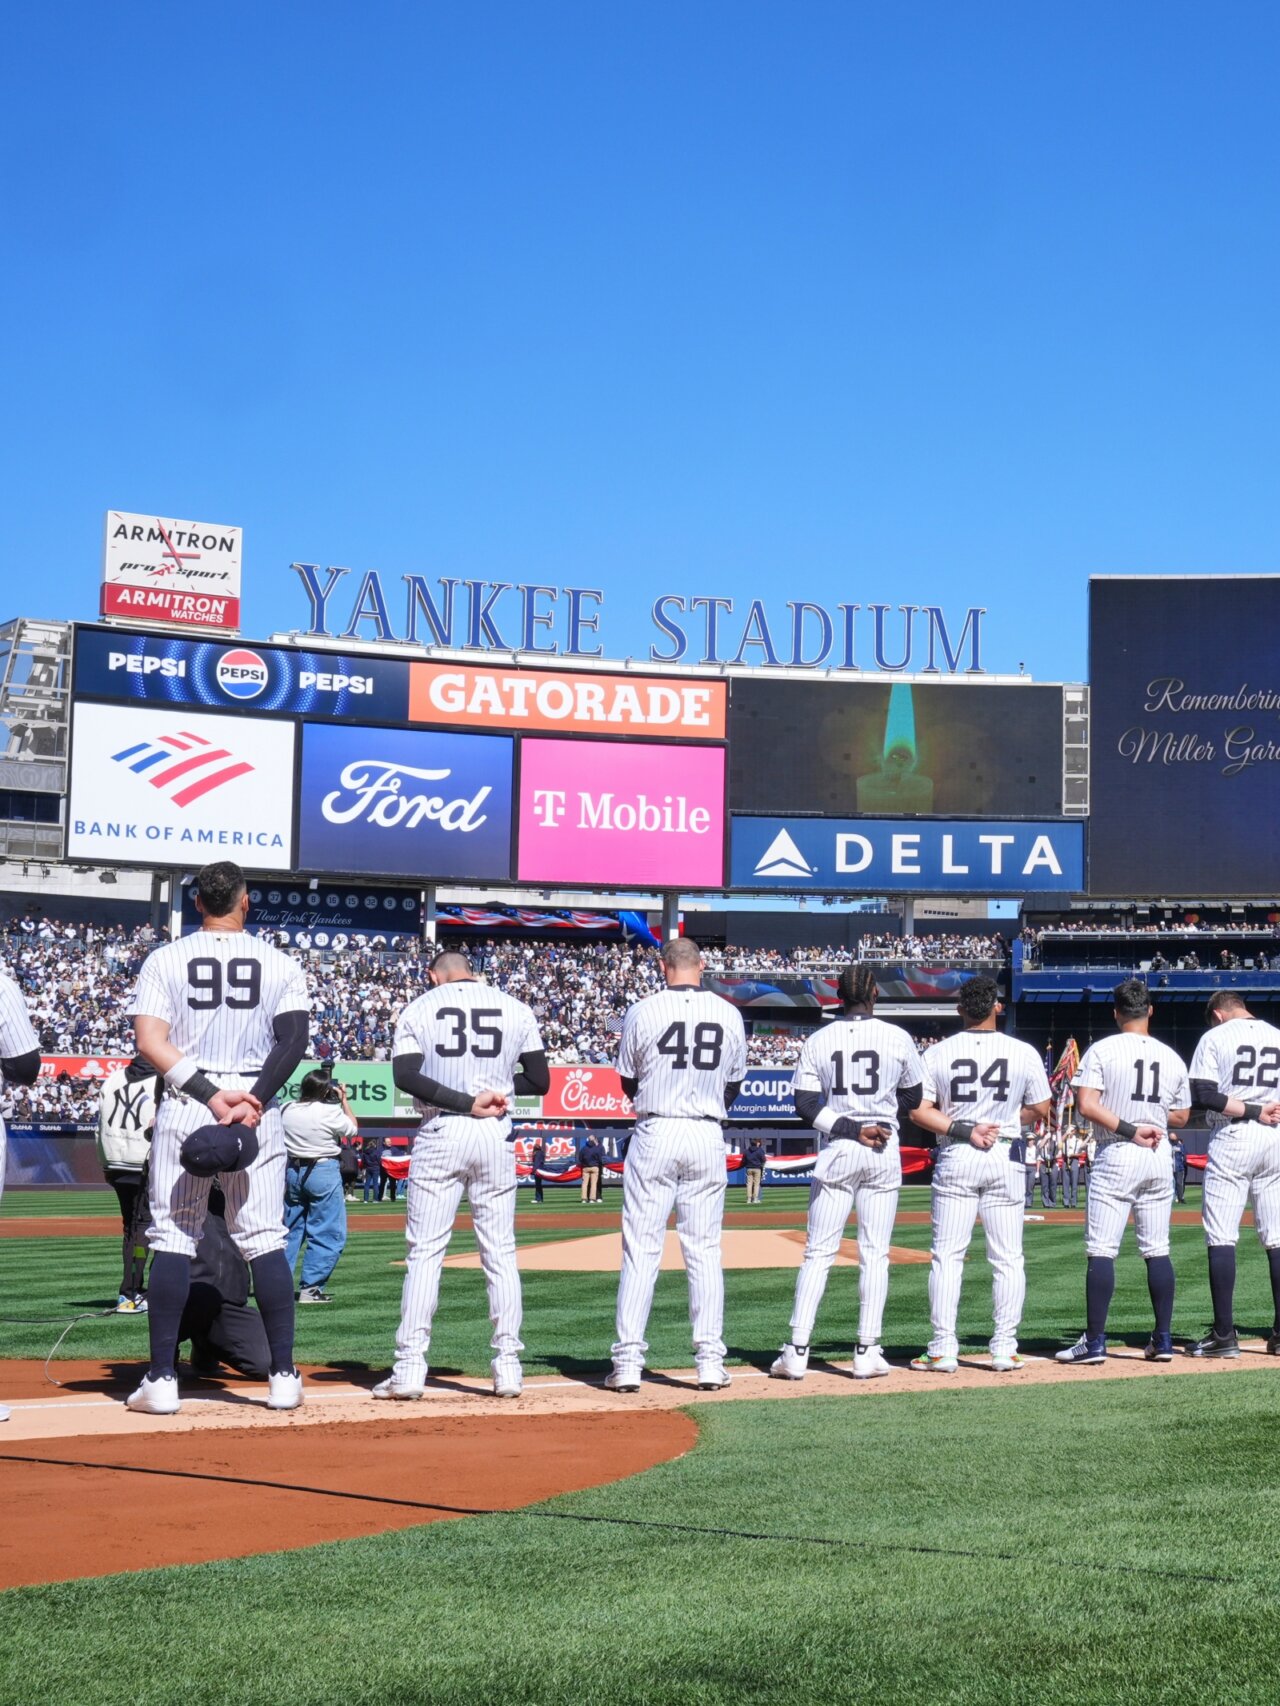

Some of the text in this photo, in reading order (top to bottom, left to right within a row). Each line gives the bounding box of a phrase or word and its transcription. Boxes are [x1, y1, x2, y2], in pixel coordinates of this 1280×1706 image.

[113, 524, 234, 552] ARMITRON
[116, 589, 226, 614] ARMITRON
[171, 609, 223, 623] WATCHES
[291, 562, 987, 673] YANKEE STADIUM
[108, 652, 186, 678] PEPSI
[220, 666, 266, 681] PEPSI
[299, 672, 374, 695] PEPSI
[429, 673, 710, 726] GATORADE
[1117, 727, 1216, 765] Miller
[321, 759, 493, 832] Ford
[576, 791, 711, 834] Mobile
[74, 820, 284, 848] BANK OF AMERICA
[835, 833, 1063, 875] DELTA
[254, 908, 352, 929] New York Yankees
[367, 898, 375, 906] 32
[186, 956, 262, 1010] 99
[434, 1007, 503, 1058] 35
[656, 1021, 724, 1071] 48
[346, 1080, 387, 1101] ats
[830, 1049, 881, 1097] 13
[949, 1058, 1010, 1103] 24
[1130, 1059, 1161, 1104] 11
[107, 1084, 150, 1131] NY
[733, 1104, 767, 1114] Margins
